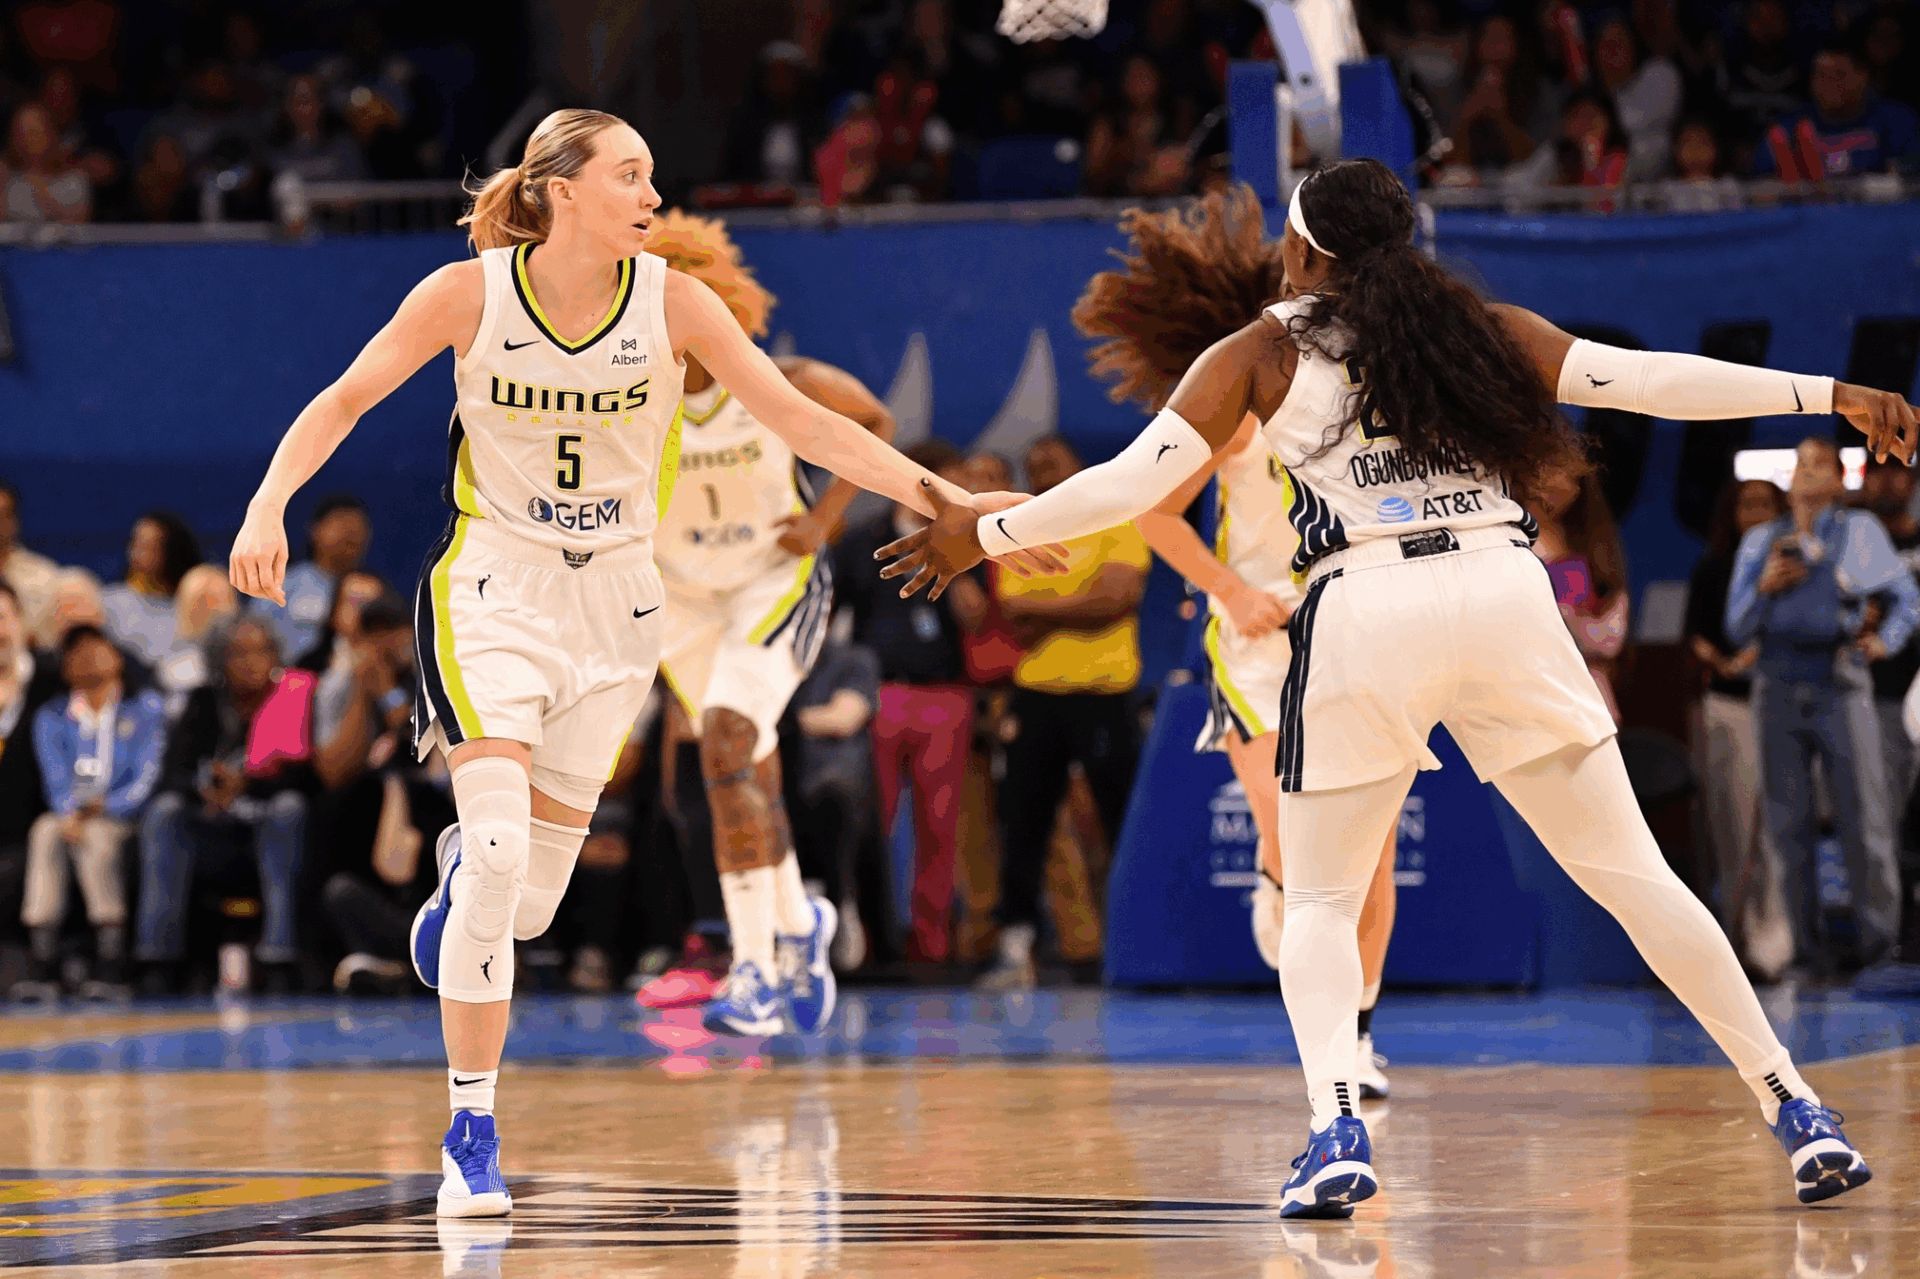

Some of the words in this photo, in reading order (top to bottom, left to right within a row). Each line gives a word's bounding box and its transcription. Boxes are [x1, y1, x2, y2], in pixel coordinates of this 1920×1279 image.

[610, 353, 648, 366] Albert
[490, 375, 650, 413] WINGS
[555, 434, 584, 491] 5
[554, 498, 622, 531] GEM
[702, 482, 720, 520] 1
[1422, 489, 1483, 520] AT&T
